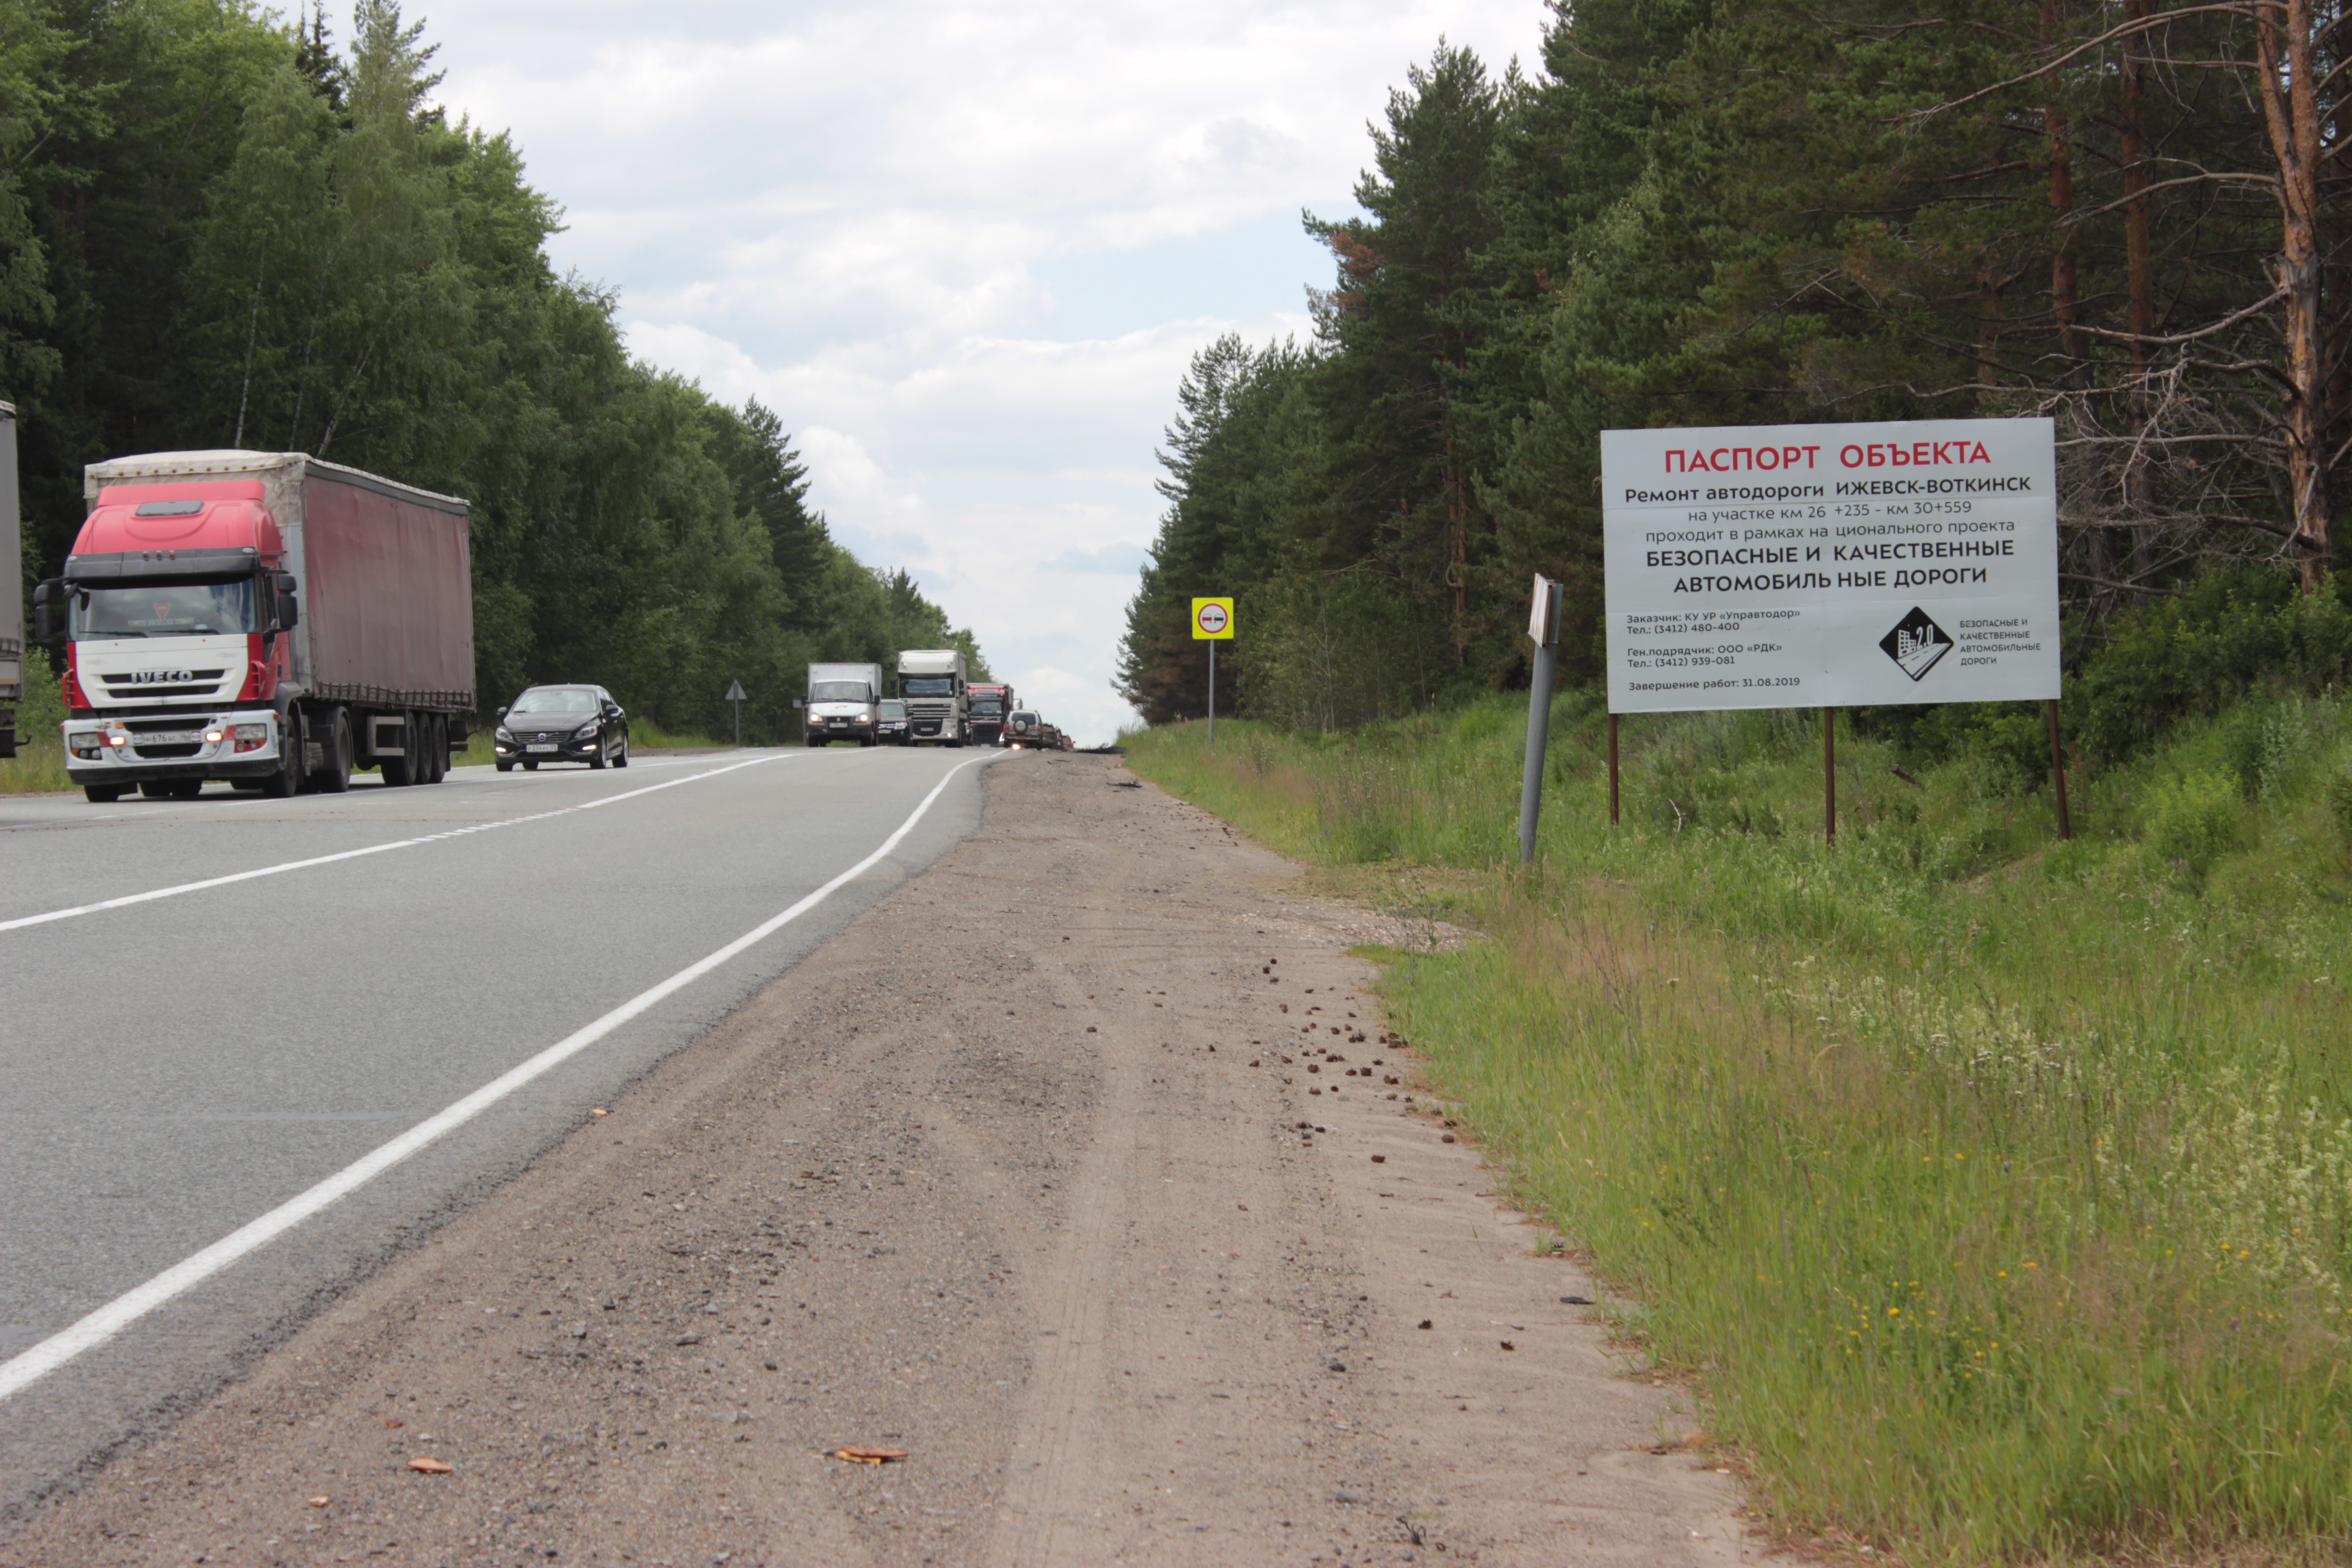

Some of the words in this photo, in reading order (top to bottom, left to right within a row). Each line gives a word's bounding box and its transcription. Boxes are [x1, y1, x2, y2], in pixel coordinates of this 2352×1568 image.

[1665, 446, 1820, 473] ПАСПОРТ
[1840, 441, 1991, 468] ОБЪЕКТА
[1626, 489, 1699, 503] Ремонт
[1706, 486, 1823, 501] автодороги
[1837, 477, 2031, 495] ИЖЕВСК-ВОТКИНСК
[1689, 511, 1707, 521] на
[1712, 510, 1775, 524] участке
[1781, 509, 1803, 519] км
[1808, 506, 1826, 518] 26
[1834, 504, 1870, 516] +235
[1887, 505, 1909, 514] км
[1914, 501, 1971, 514] 30+559
[1646, 531, 1724, 545] проходит
[1730, 530, 1738, 540] в
[1744, 529, 1804, 542] рамках
[1810, 528, 1828, 537] на
[1836, 523, 1943, 538] ционального
[1948, 521, 2014, 535] проекта
[1647, 547, 1798, 567] БЕЗОПАСНЫЕ
[1806, 546, 1820, 561] И
[1834, 540, 2014, 561] КАЧЕСТВЕННЫЕ
[1674, 573, 1831, 593] АВТОМОБИЛЬ
[1838, 571, 1886, 588] НЫЕ
[1894, 568, 1986, 588] ДОРОГИ
[1627, 615, 1681, 623] Заказчик:
[1685, 613, 1699, 621] КУ
[1702, 612, 1716, 621] УР
[1720, 610, 1800, 621] «Управтодор»
[1960, 619, 2019, 628] БЕЗОПАСНЫЕ
[1627, 626, 1651, 634] Тел.:
[1654, 623, 1687, 634] (3412)
[1691, 622, 1740, 632] 480-400
[1916, 624, 1934, 646] 2.0
[1960, 631, 2030, 640] КАЧЕСТВЕННЫЕ
[1627, 647, 1714, 658] Ген.подрядчик:
[1718, 644, 1744, 653] ООО
[1747, 643, 1782, 653] «РДК»
[1960, 643, 2041, 653] АВТОМОБИЛЬНЫЕ
[1627, 659, 1651, 668] Тел.:
[1655, 656, 1688, 667] (3412)
[1691, 656, 1735, 666] 939-081
[1960, 657, 1997, 666] ДОРОГИ
[131, 670, 193, 685] IVECO
[1629, 681, 1700, 692] Завершение
[1703, 679, 1739, 690] работ:
[1742, 677, 1800, 687] 31.08.2019
